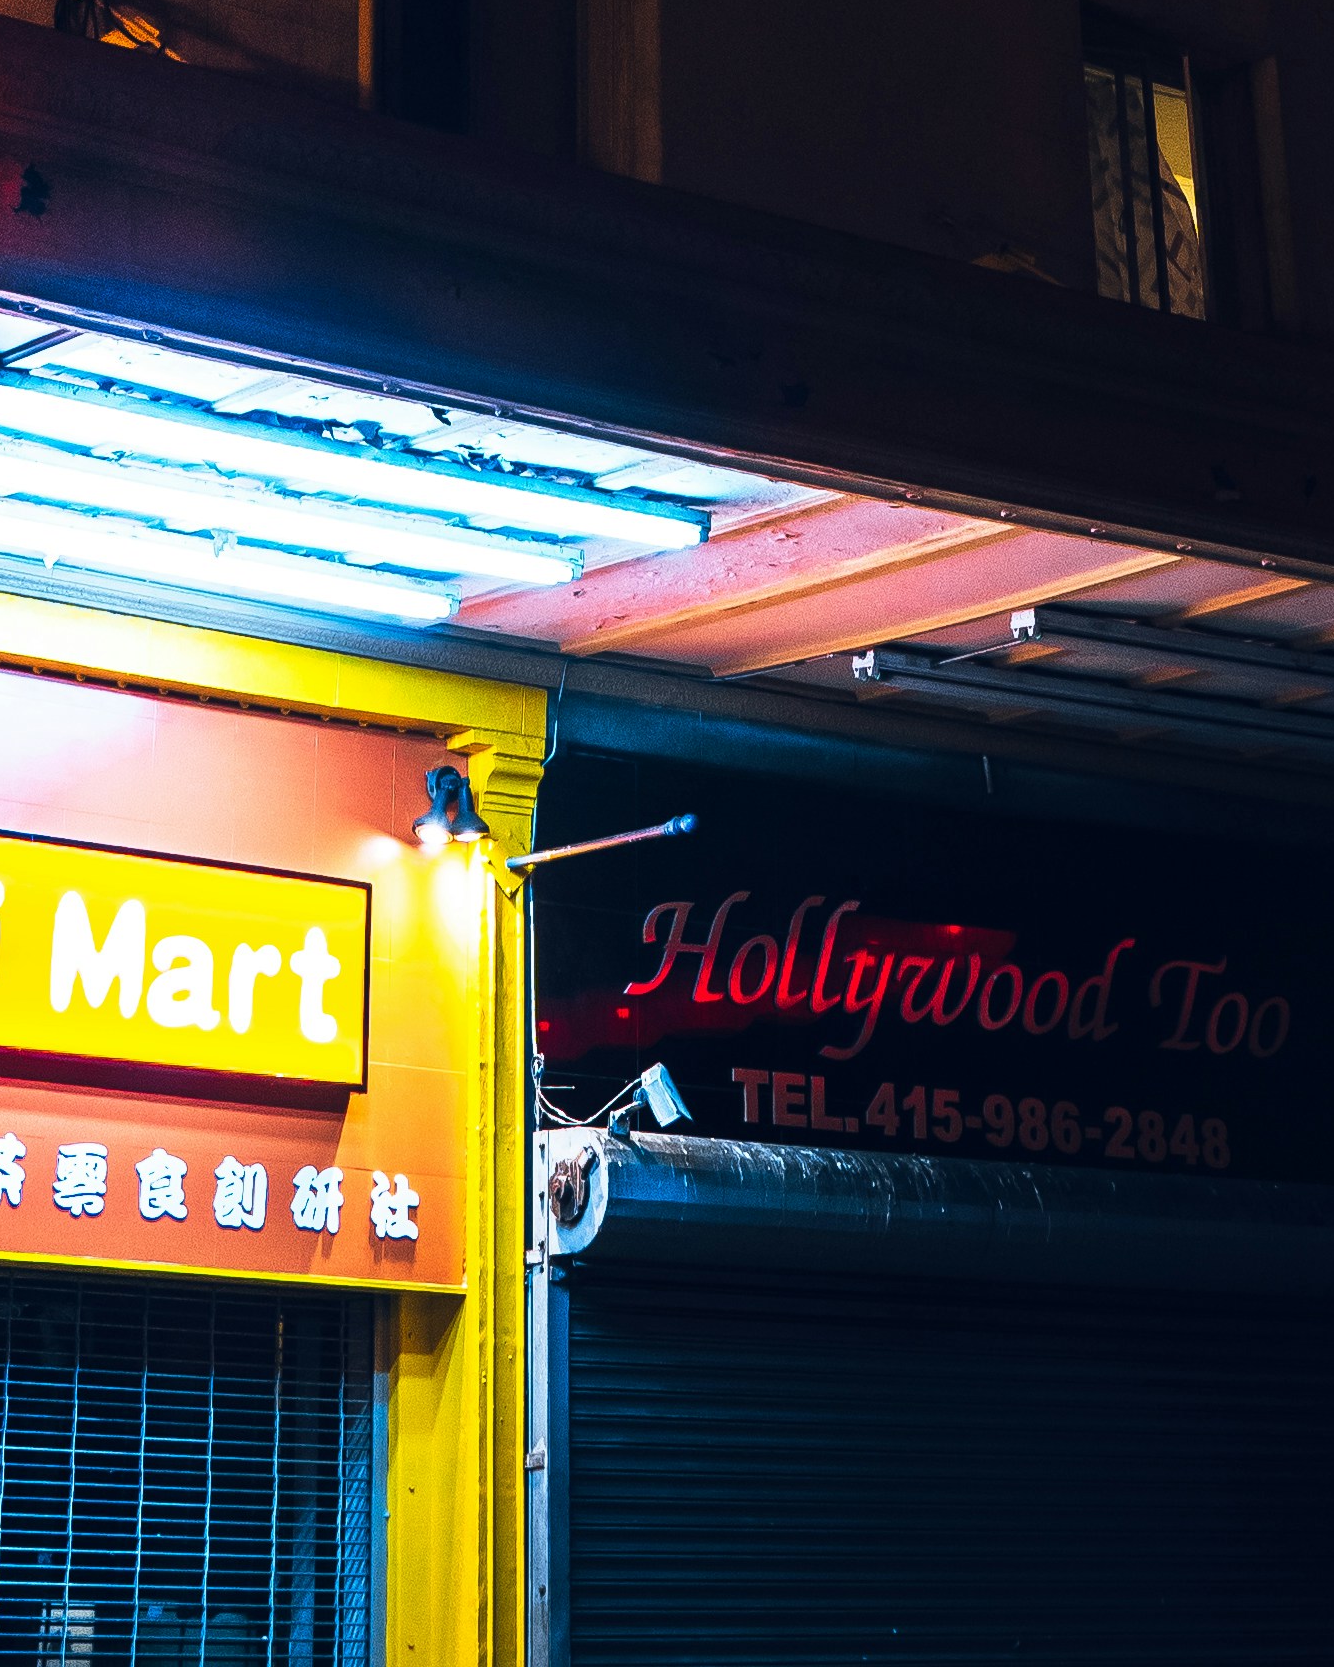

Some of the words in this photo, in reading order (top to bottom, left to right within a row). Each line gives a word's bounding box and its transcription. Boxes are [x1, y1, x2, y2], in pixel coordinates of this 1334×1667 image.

[50, 890, 340, 1044] Mart
[622, 890, 1136, 1061] Hollywood
[1148, 955, 1292, 1059] Too
